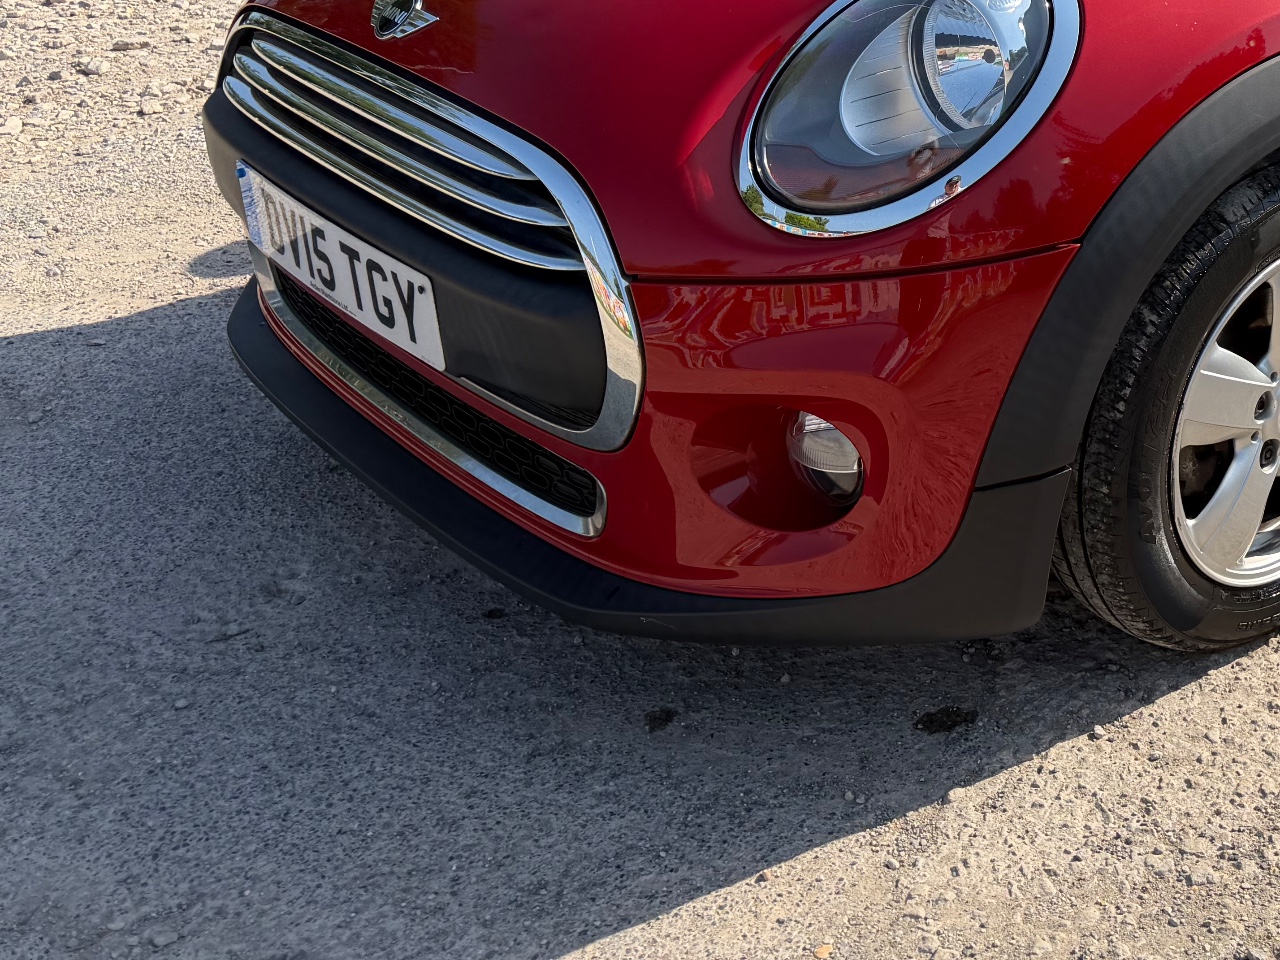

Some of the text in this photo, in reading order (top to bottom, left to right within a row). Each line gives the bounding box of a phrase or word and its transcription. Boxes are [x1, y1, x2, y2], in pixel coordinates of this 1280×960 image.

[382, 5, 408, 24] MINI
[261, 188, 418, 345] DV15 TGY
